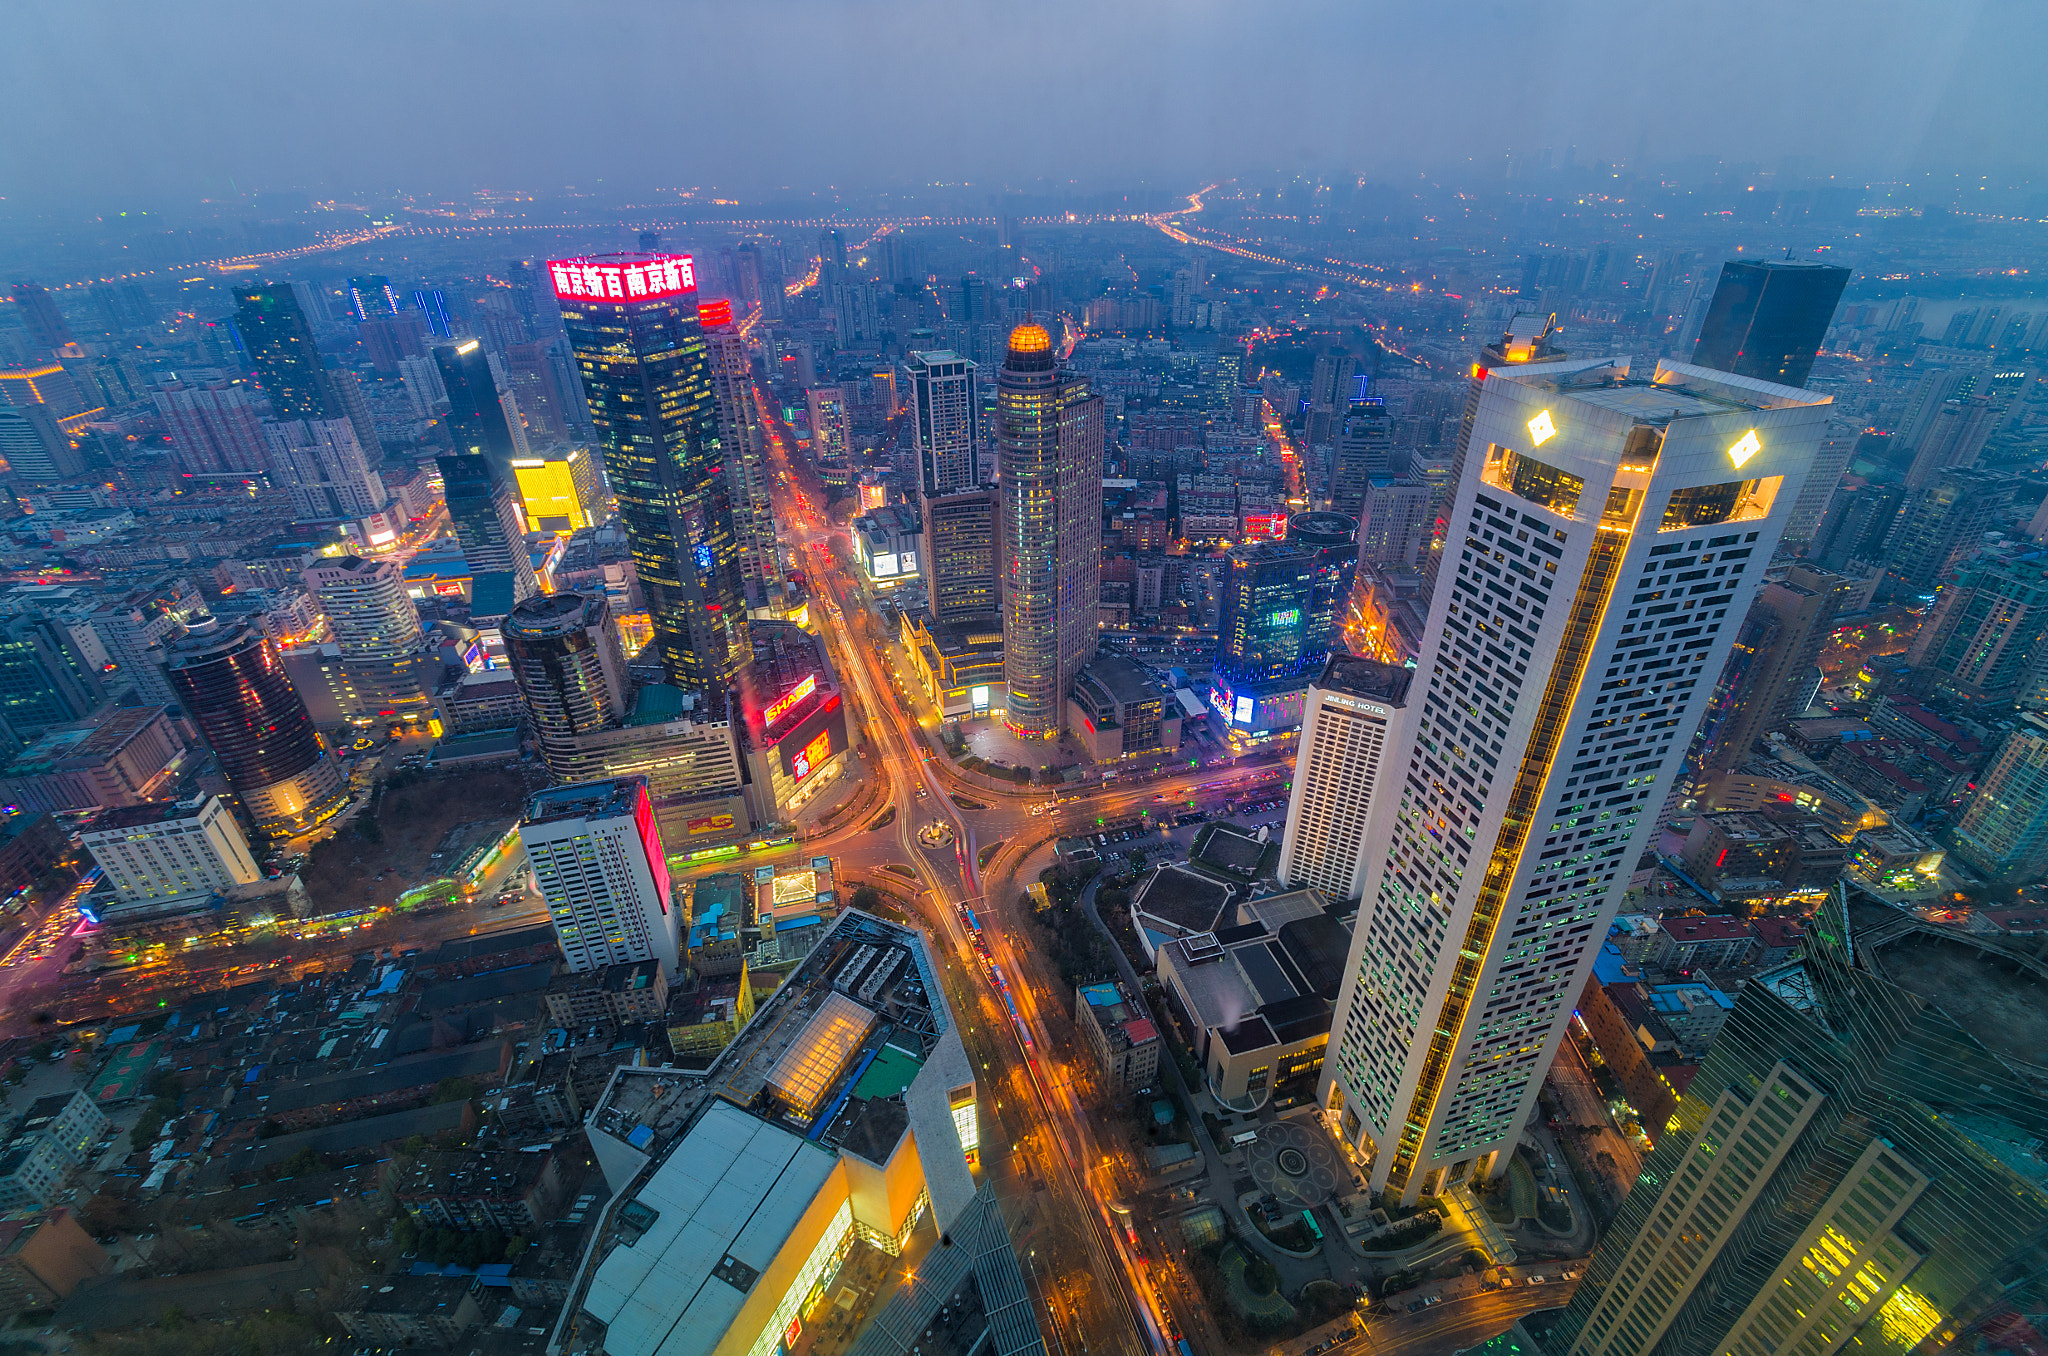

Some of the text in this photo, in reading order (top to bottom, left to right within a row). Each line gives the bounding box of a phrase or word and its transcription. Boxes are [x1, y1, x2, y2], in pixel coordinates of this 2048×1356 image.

[551, 263, 624, 298] 南京新百
[624, 258, 695, 298] 南京新百
[766, 678, 815, 721] SHARP
[1325, 694, 1386, 715] JINLING HOTEL
